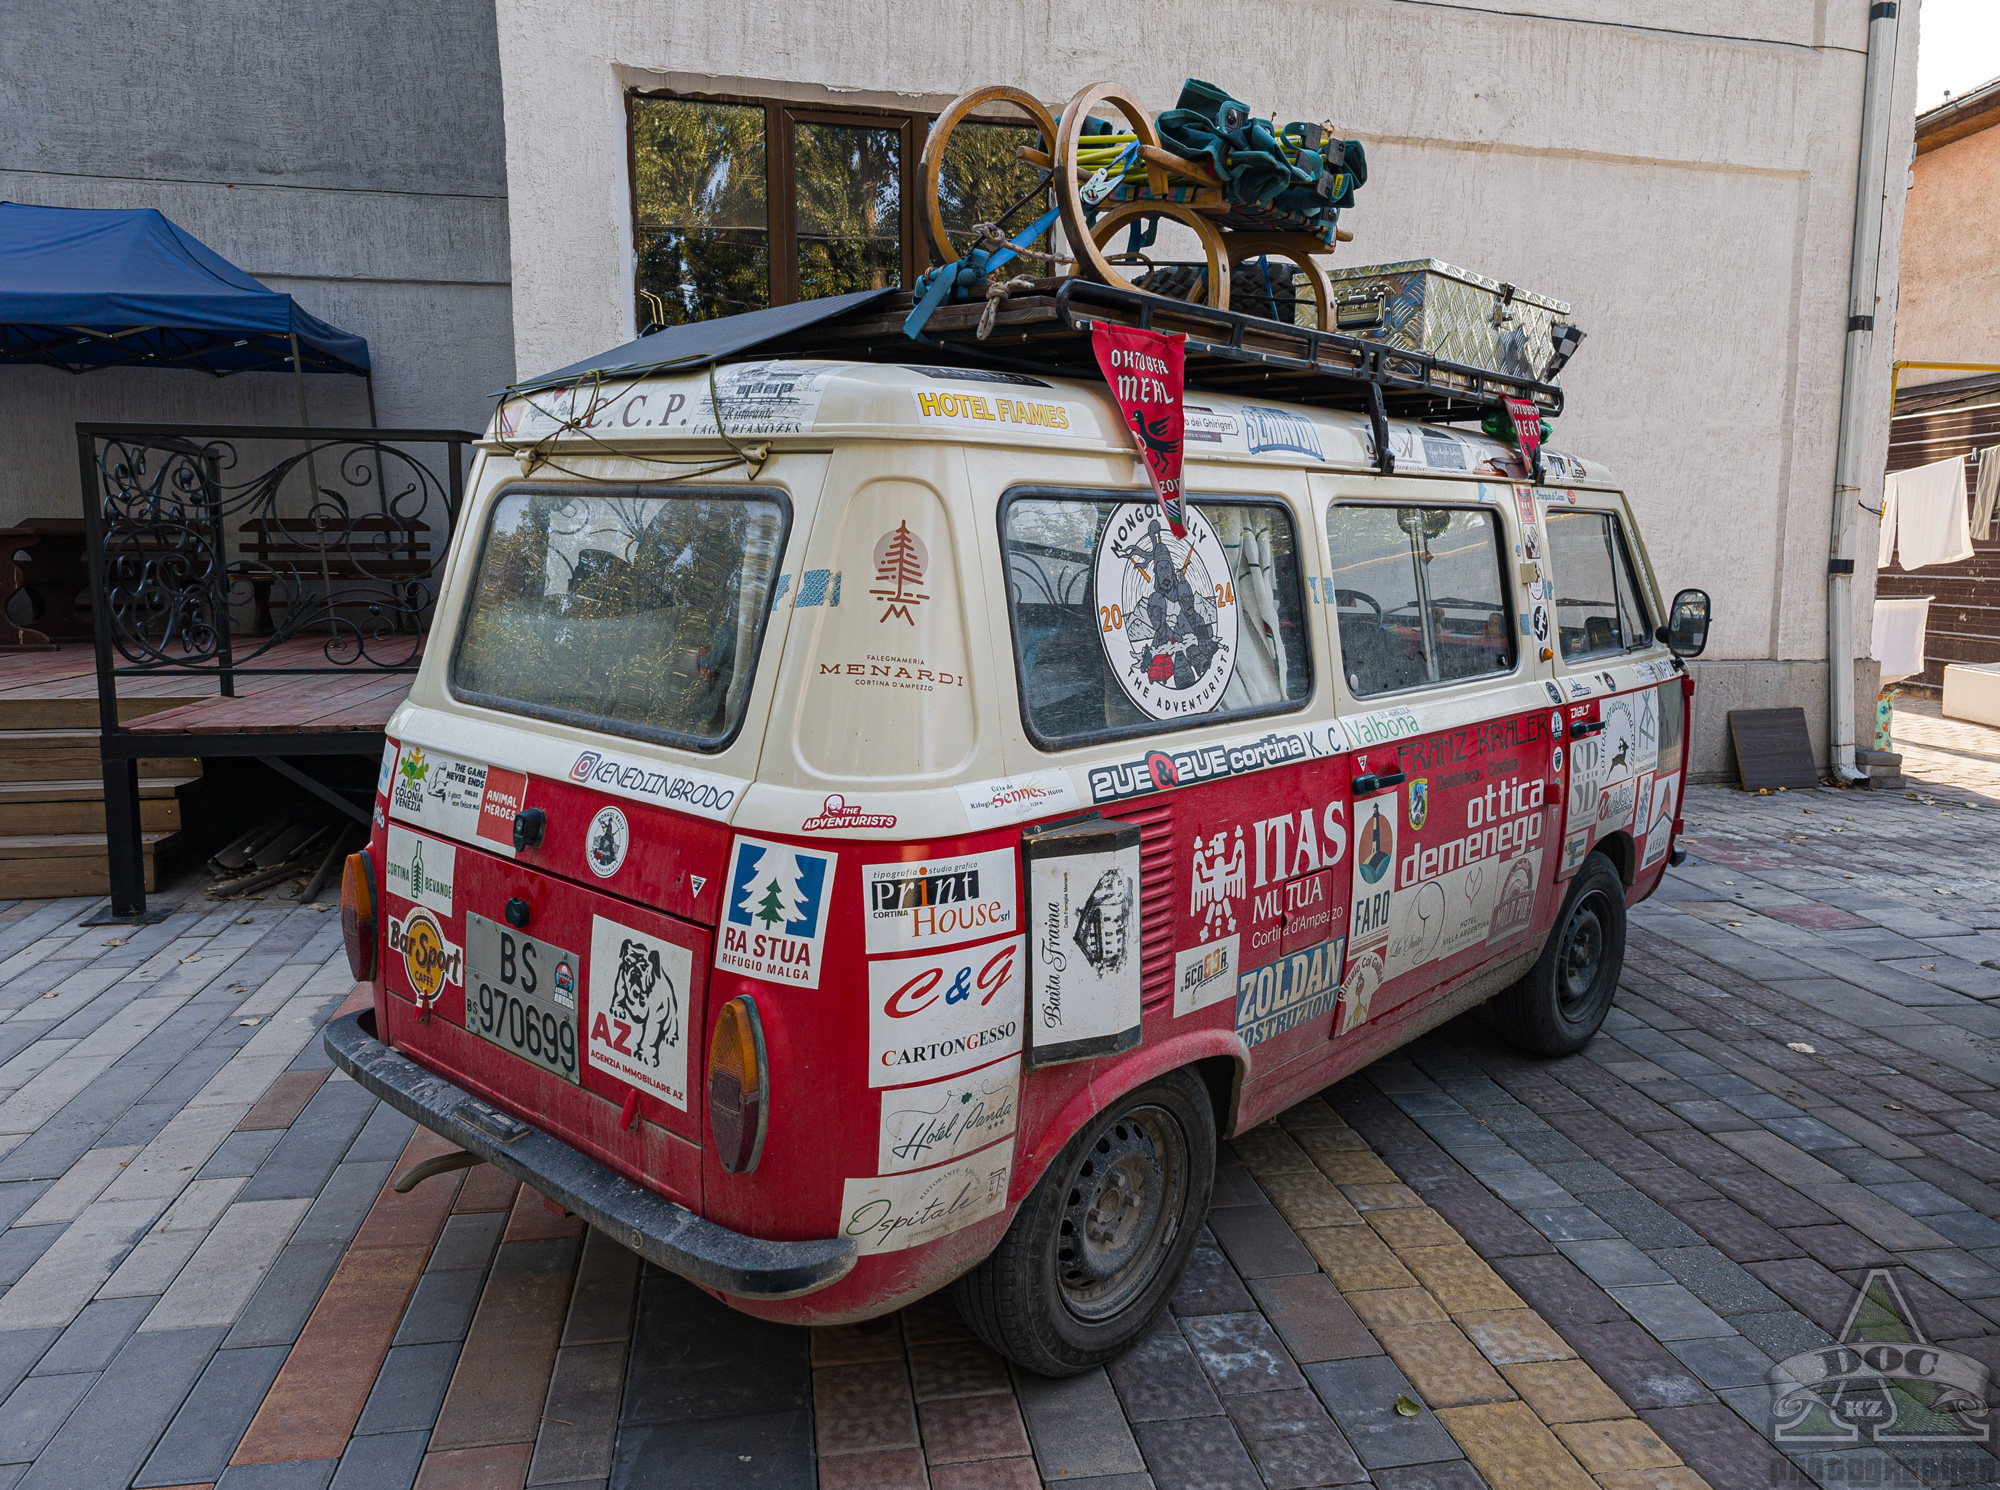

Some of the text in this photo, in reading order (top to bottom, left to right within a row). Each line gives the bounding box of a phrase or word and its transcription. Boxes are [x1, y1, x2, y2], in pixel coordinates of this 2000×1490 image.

[1110, 348, 1169, 375] OKTOBER
[1117, 374, 1175, 405] MERL
[918, 392, 1070, 430] HOTEL FIAMES
[1100, 582, 1234, 632] 20 24
[819, 663, 963, 687] MENARDI
[867, 654, 925, 666] FALEGNAMERIA
[855, 679, 933, 692] CORTINA D'AMPEZZO
[1128, 644, 1230, 713] THE ADVENTURISTS
[1345, 715, 1420, 745] Valbona
[1397, 731, 1468, 773] FRANZ
[1476, 713, 1548, 756] KRALER
[401, 779, 421, 792] AMICI
[446, 771, 484, 788] NEVER ENDS
[454, 763, 486, 779] THE GAME
[1437, 757, 1519, 792] Dobbiaco Cortina
[395, 787, 423, 803] COLONIA
[395, 796, 420, 813] VENEZIA
[484, 802, 516, 822] HEROES
[486, 789, 519, 808] ANIMAL
[992, 787, 1047, 808] Sennes
[1467, 777, 1544, 829] ottica
[804, 815, 895, 830] ADVENTURISTS
[1252, 800, 1347, 889] ITAS
[1401, 811, 1543, 888] demenego
[387, 861, 410, 882] CORTINA
[873, 861, 978, 879] tipografia studio grafico
[425, 877, 452, 899] BEVANDE
[873, 871, 974, 911] Print
[1252, 877, 1324, 925] MUTUA
[873, 909, 908, 919] CORTINA
[911, 901, 1010, 938] House srl
[1252, 905, 1343, 949] Cortina d'Ampezzo
[1354, 889, 1391, 937] FARO
[1460, 916, 1476, 929] HOTEL
[390, 920, 416, 957] Bar
[415, 932, 461, 984] Sport
[500, 931, 537, 994] BS
[723, 926, 811, 967] RA STUA
[722, 953, 809, 981] RIFUGIO MALGA
[1041, 901, 1067, 1029] Baita Traina
[1238, 939, 1345, 1026] ZOLDAN
[467, 999, 478, 1014] BS
[479, 982, 575, 1073] 970699
[590, 1011, 633, 1058] AZ
[881, 1020, 1016, 1067] CARTONGESSO
[590, 1049, 684, 1102] AGENZIA IMMOBILIARE AZ
[892, 1095, 1013, 1161] Hotel Panda
[919, 1168, 960, 1200] RISTORANTE
[845, 1181, 982, 1246] Ospitale
